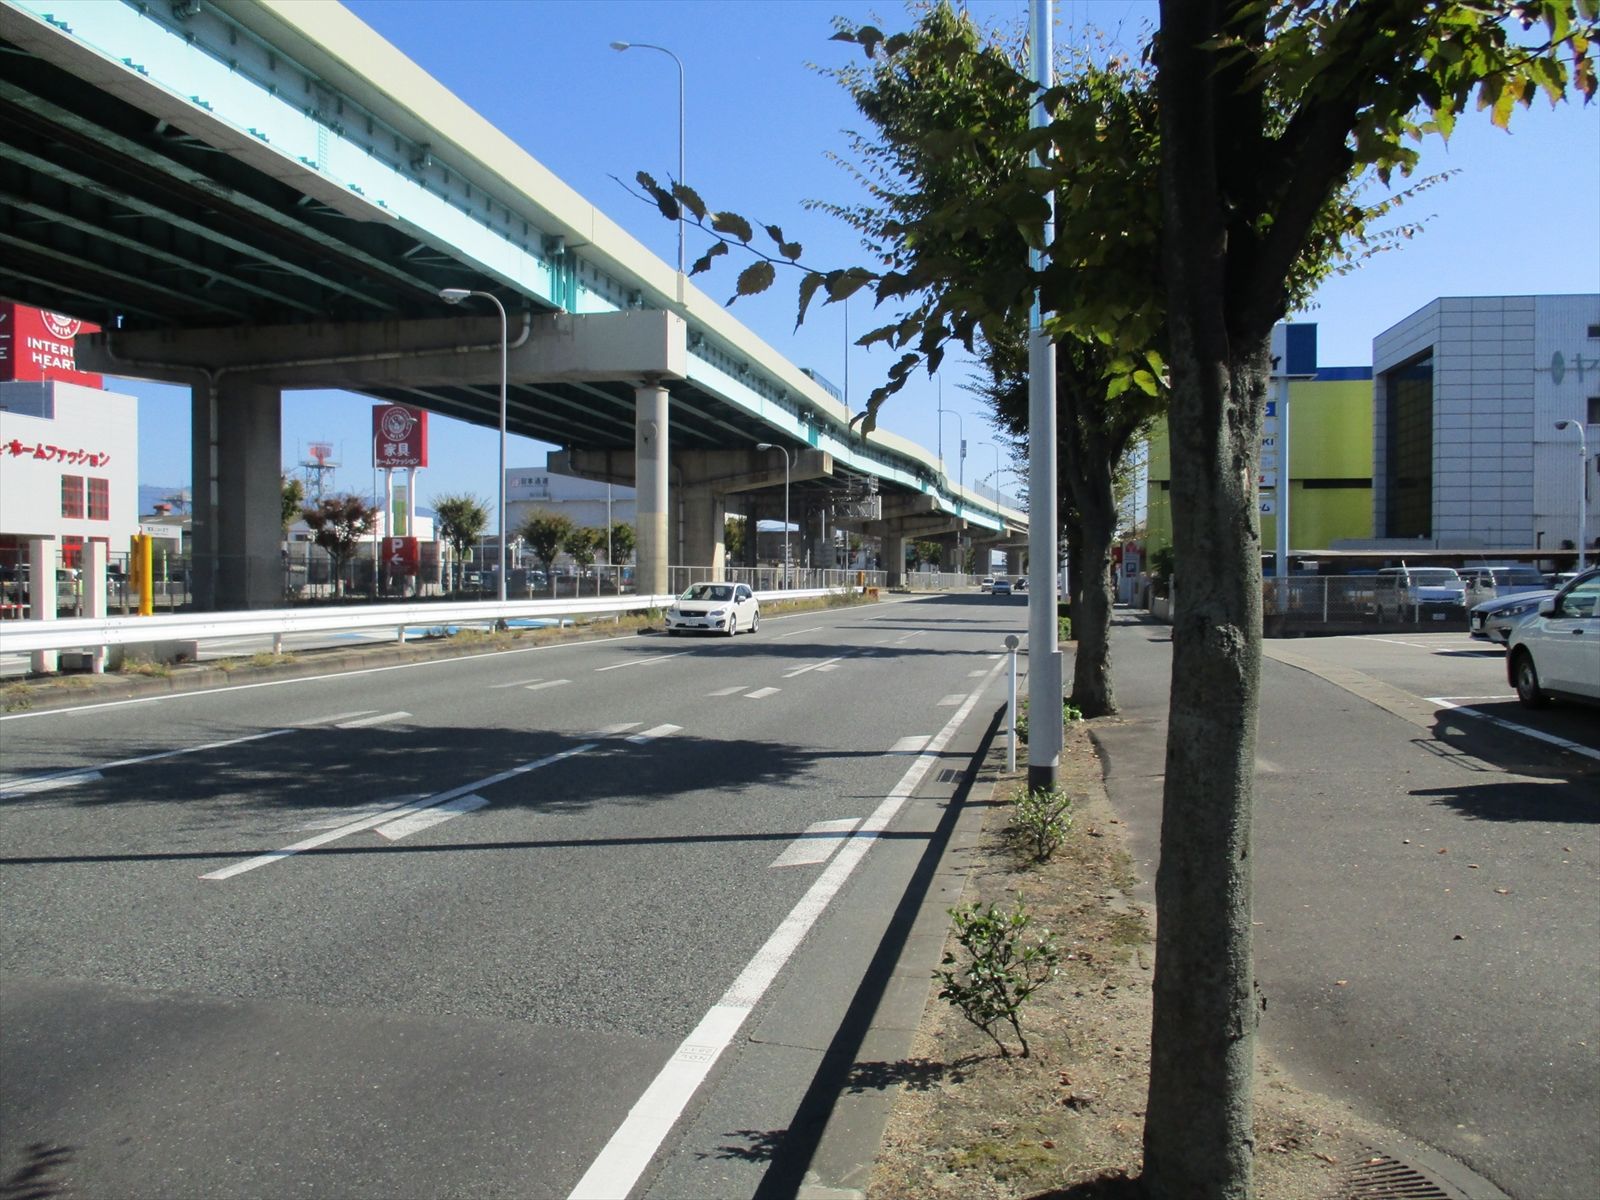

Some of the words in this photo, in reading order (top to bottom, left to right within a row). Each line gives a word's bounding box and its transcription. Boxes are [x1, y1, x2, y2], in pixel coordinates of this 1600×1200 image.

[0, 439, 110, 467] ホームファッション
[383, 442, 410, 457] 家具
[391, 538, 404, 553] P
